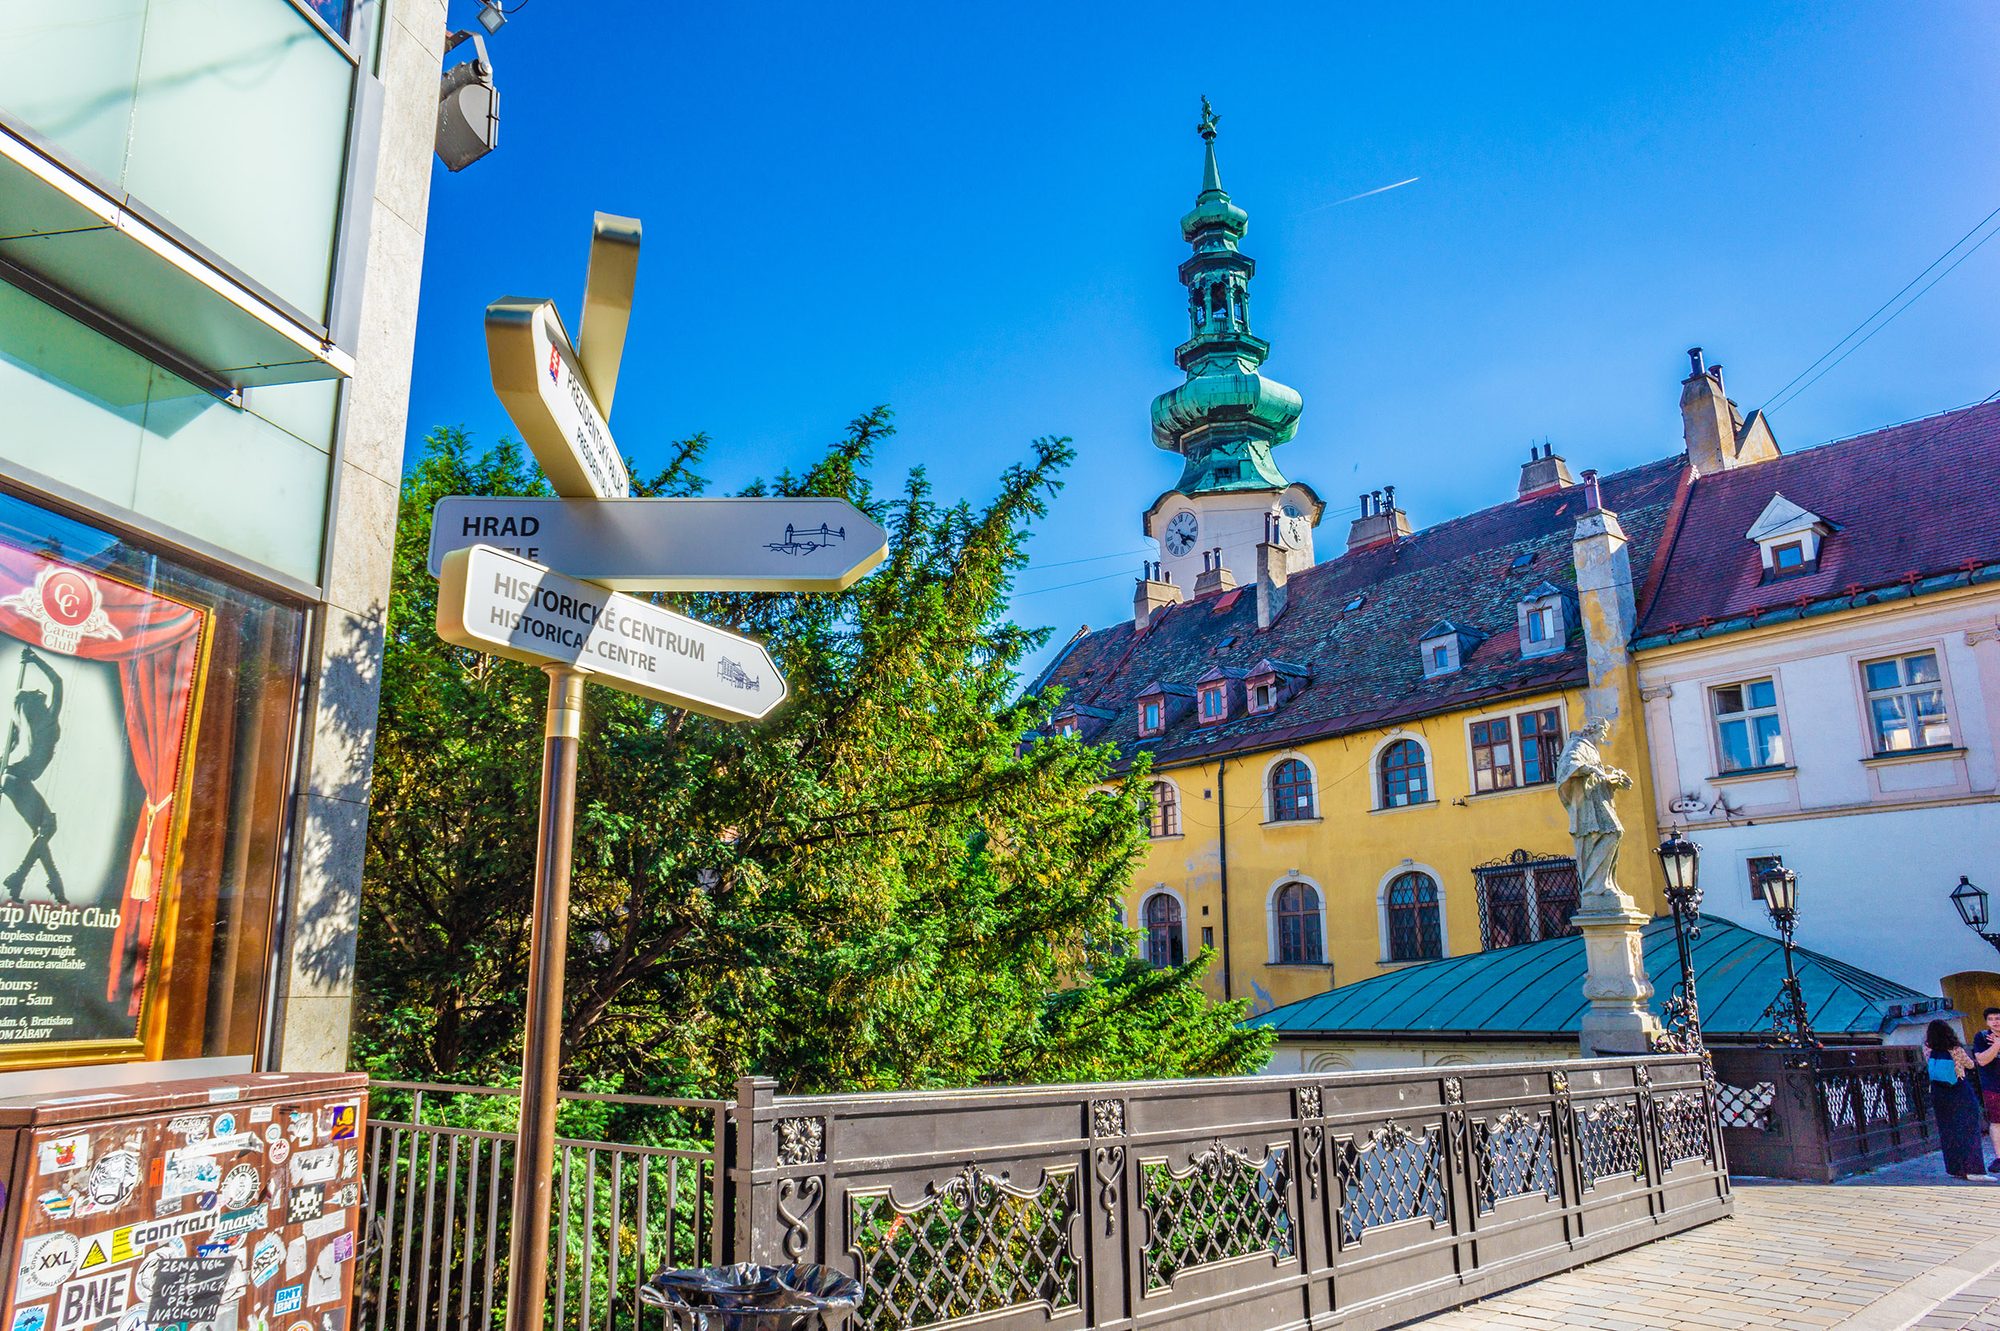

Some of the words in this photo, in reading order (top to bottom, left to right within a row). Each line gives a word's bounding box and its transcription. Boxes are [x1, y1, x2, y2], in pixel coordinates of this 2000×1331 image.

[462, 516, 540, 537] HRAD
[494, 572, 616, 633] HISTORICKÉ
[619, 616, 705, 662] CENTRUM
[490, 606, 593, 654] HISTORICAL
[597, 640, 657, 673] CENTRE
[27, 904, 80, 930] Night
[82, 908, 121, 928] Club
[0, 930, 35, 943] topless
[36, 931, 73, 943] dancers
[24, 947, 51, 958] every
[51, 946, 76, 959] night
[15, 958, 45, 970] dance
[45, 959, 86, 970] available
[26, 994, 53, 1006] 5am
[30, 1016, 73, 1026] Bratislava
[14, 1026, 52, 1039] ZÁBAVY
[135, 1211, 218, 1245] contrast
[38, 1251, 72, 1271] XXL
[174, 1272, 196, 1285] JE
[62, 1274, 127, 1326] BNE
[278, 1287, 300, 1301] BNT
